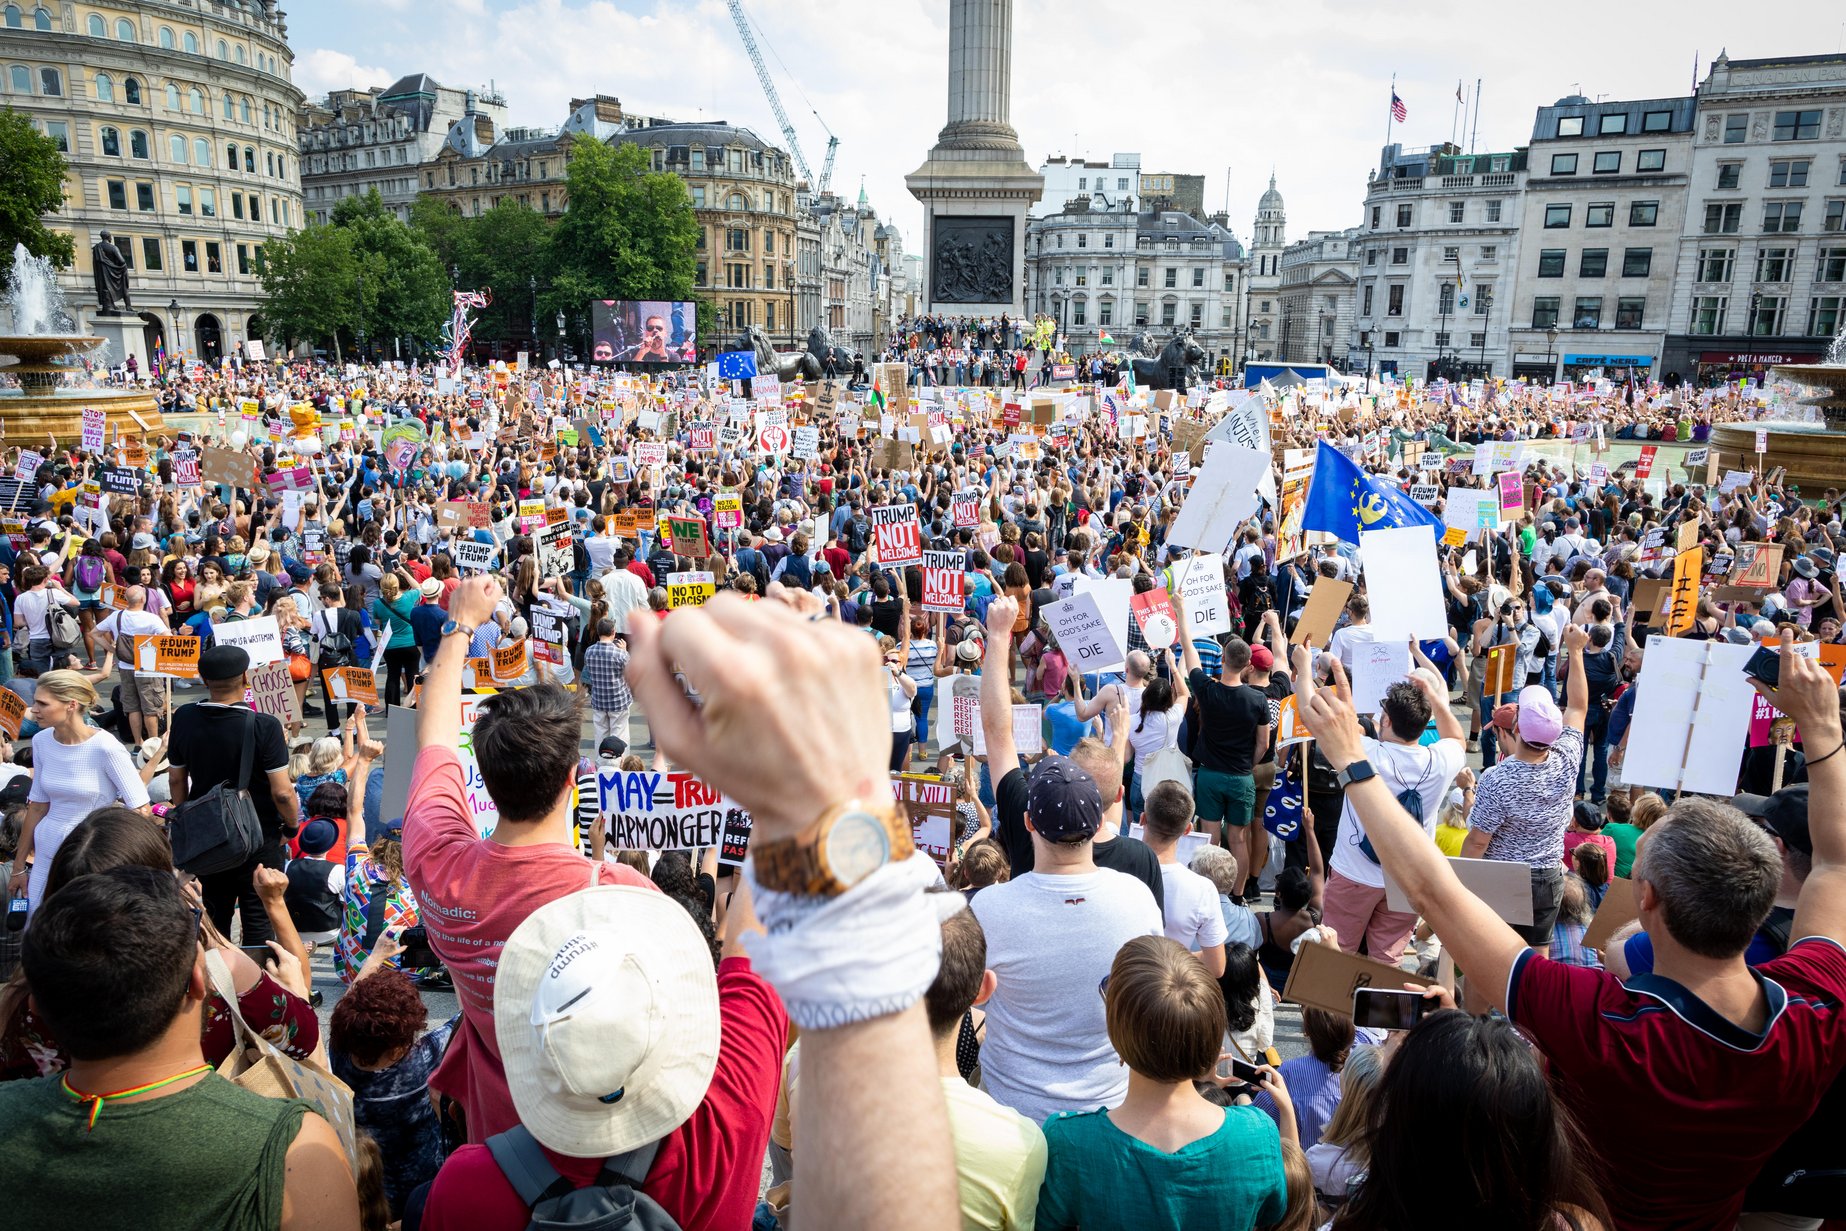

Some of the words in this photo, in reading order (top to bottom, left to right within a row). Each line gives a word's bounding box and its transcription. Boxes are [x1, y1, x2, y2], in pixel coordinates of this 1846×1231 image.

[1738, 354, 1752, 362] PRET
[1758, 355, 1783, 363] MANGER
[754, 384, 780, 394] HUMAN
[84, 409, 103, 418] STOP
[928, 412, 944, 426] NOT
[690, 422, 712, 430] TRUMP
[1230, 414, 1257, 450] INJUST
[85, 436, 101, 447] ICE
[691, 430, 713, 442] NOT
[174, 450, 196, 461] TRUMP
[176, 460, 197, 476] NOT
[104, 472, 142, 487] Trump
[953, 492, 977, 504] TRUMP
[873, 506, 915, 526] TRUMP
[955, 502, 977, 520] NOT
[956, 517, 979, 526] WELCOME
[670, 520, 700, 538] WE
[878, 521, 916, 550] NOT
[459, 544, 491, 554] #DUMP
[556, 538, 572, 548] BACK
[460, 552, 489, 563] TRUMP
[880, 546, 920, 560] WELCOME
[924, 553, 964, 570] TRUMP
[1709, 566, 1728, 575] TRUMP
[926, 568, 963, 594] NOT
[1186, 577, 1198, 586] OH
[1200, 574, 1214, 582] FOR
[672, 586, 687, 597] NO
[690, 586, 703, 596] TO
[1182, 587, 1204, 598] GOD'S
[1206, 583, 1222, 592] SAKE
[924, 592, 962, 606] WELCOME
[1198, 598, 1209, 607] JUST
[1136, 608, 1150, 616] THIS
[1157, 602, 1170, 610] THE
[1195, 608, 1216, 624] DIE
[533, 612, 556, 629] DUMP
[1060, 617, 1074, 627] OH
[1074, 612, 1089, 623] FOR
[533, 626, 562, 644] TRUMP
[1058, 626, 1082, 638] GOD'S
[1082, 620, 1102, 632] SAKE
[160, 638, 197, 648] #DUMP
[221, 637, 238, 646] TRUMP
[244, 636, 248, 644] A
[248, 632, 275, 644] WASTEMAN
[1078, 636, 1089, 644] JUST
[160, 648, 195, 658] TRUMP
[495, 642, 524, 659] #DUMP
[1078, 643, 1104, 658] DIE
[496, 650, 523, 667] TRUMP
[252, 668, 292, 694] CHOOSE
[2, 692, 25, 712] #DUMP
[258, 691, 290, 716] LOVE
[1, 702, 22, 721] TRUMP
[954, 705, 972, 714] RESI
[954, 712, 972, 720] RESI
[1756, 708, 1770, 720] #1
[954, 720, 972, 728] RESI
[954, 726, 972, 736] RESI
[725, 834, 749, 845] REF
[723, 846, 745, 856] FAS
[421, 890, 477, 920] Nomadic:
[442, 934, 457, 943] the
[458, 936, 471, 945] life
[472, 938, 483, 946] of
[550, 940, 598, 980] #trump
[486, 975, 496, 984] di
